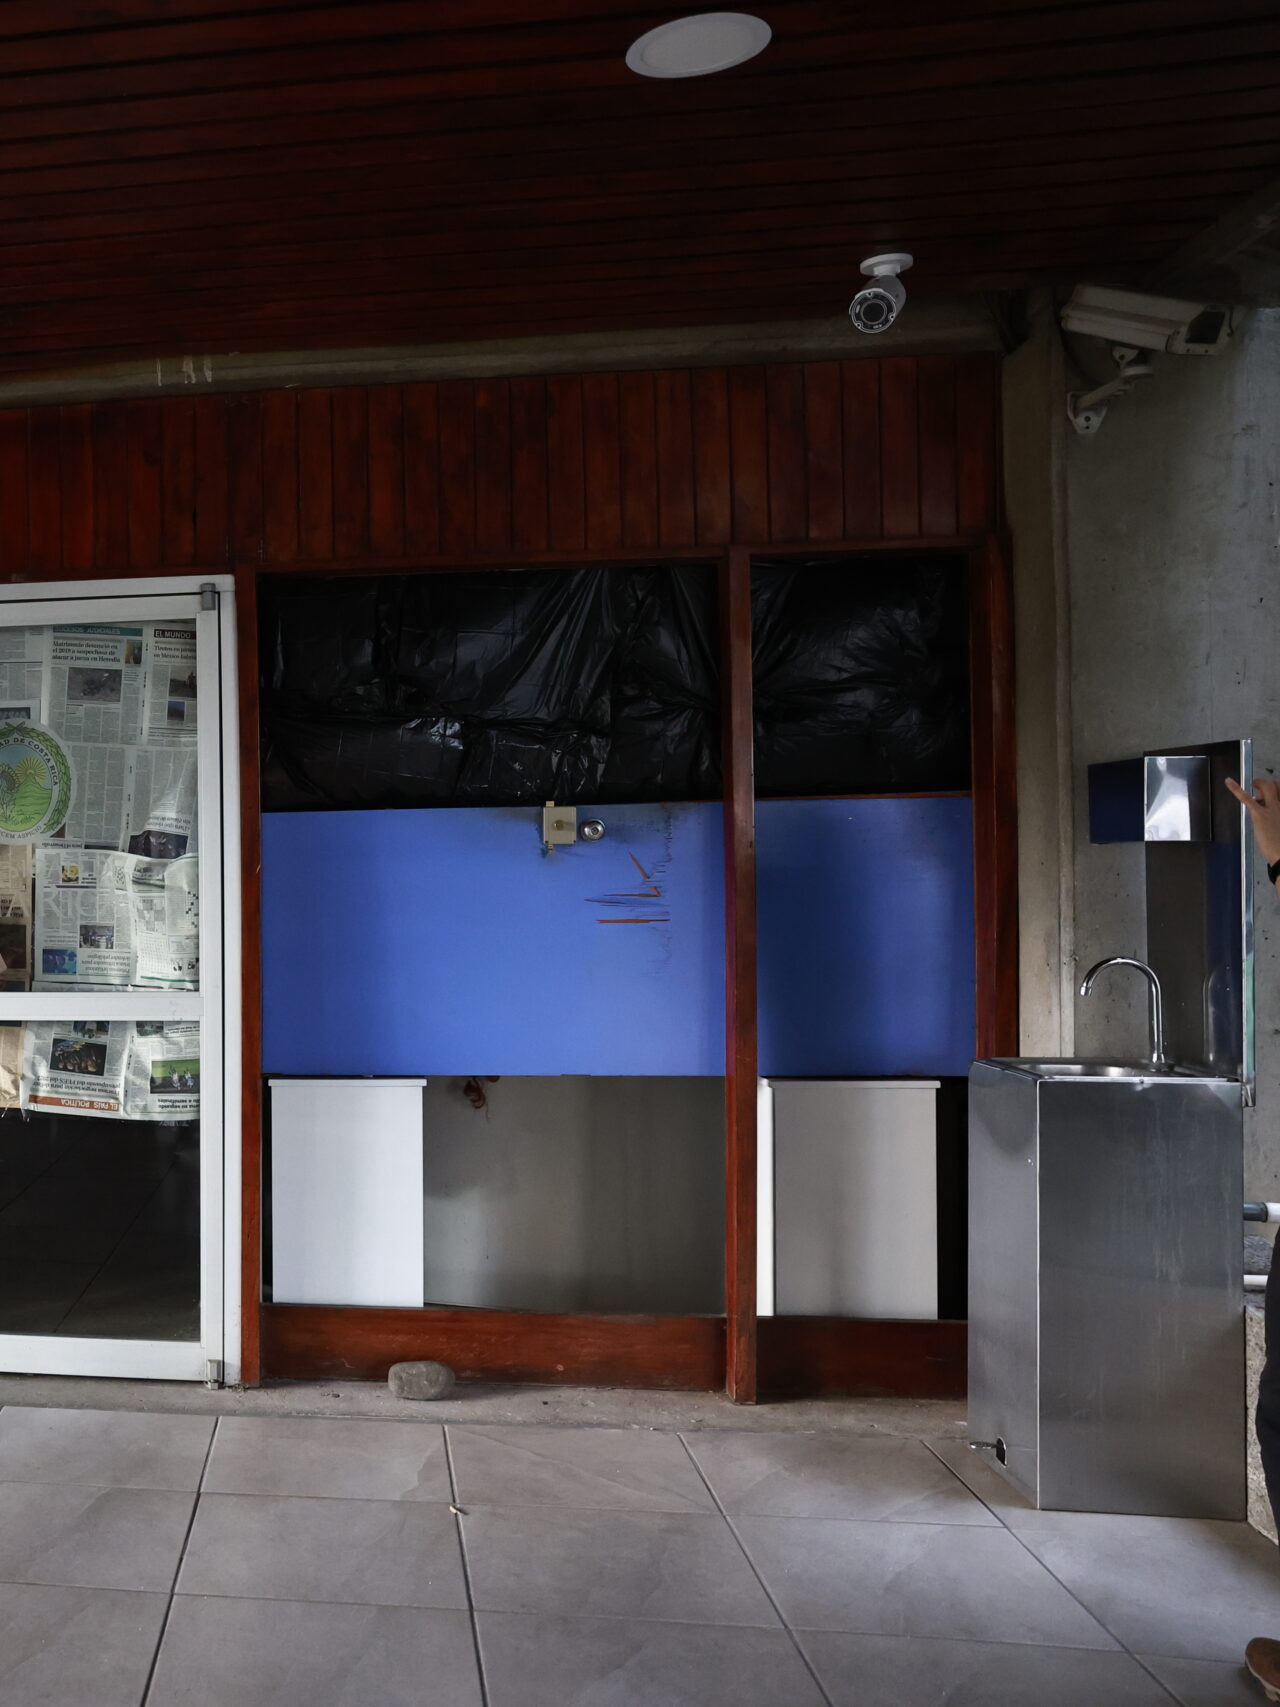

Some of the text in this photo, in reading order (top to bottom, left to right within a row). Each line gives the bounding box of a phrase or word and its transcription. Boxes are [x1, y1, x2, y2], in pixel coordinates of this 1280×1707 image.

[165, 631, 191, 639] MUNDO
[28, 740, 51, 763] COSTA
[49, 764, 59, 786] RICA
